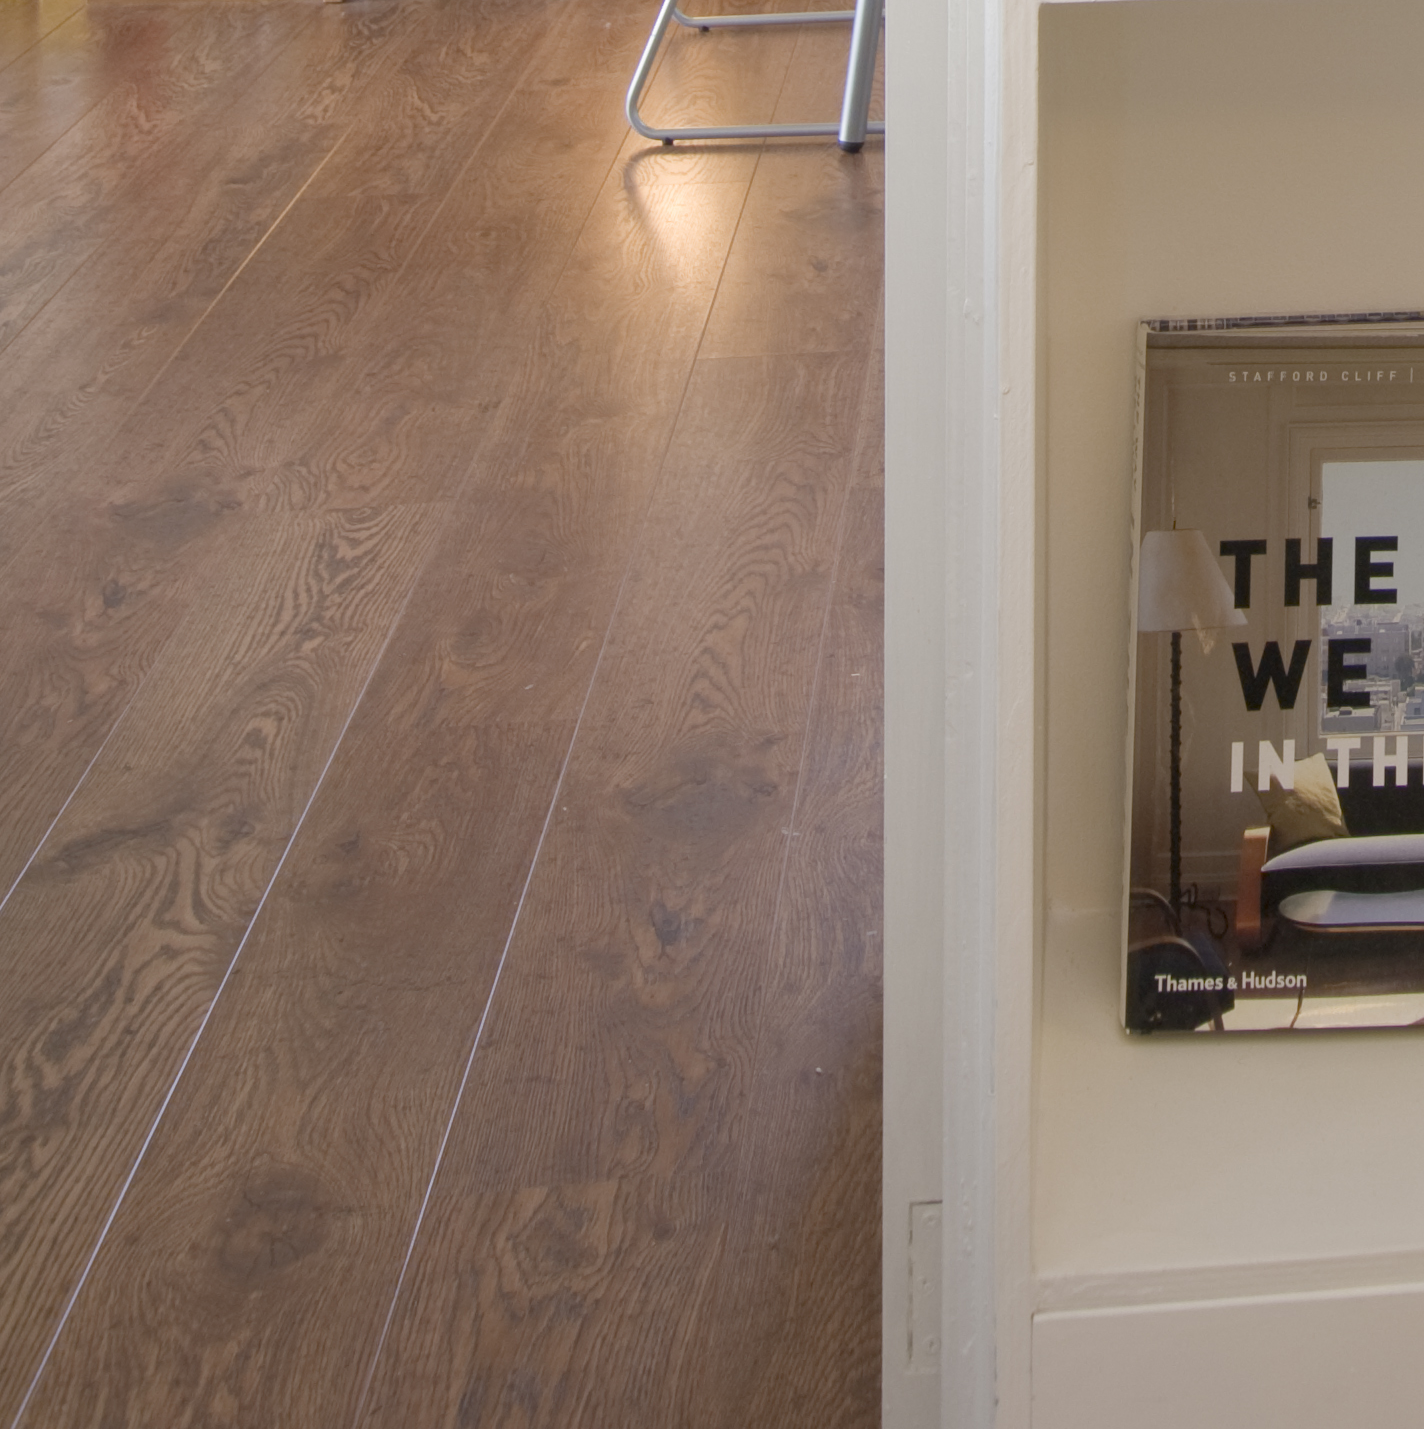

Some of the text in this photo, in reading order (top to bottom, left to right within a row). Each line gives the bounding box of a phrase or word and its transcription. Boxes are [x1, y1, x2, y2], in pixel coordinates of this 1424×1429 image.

[1228, 370, 1329, 382] STAFFORD
[1341, 370, 1398, 381] CLIFF
[1219, 535, 1399, 609] THE
[1232, 639, 1373, 712] WE
[1229, 739, 1297, 792] IN
[1155, 969, 1308, 994] Thames & Hudson
